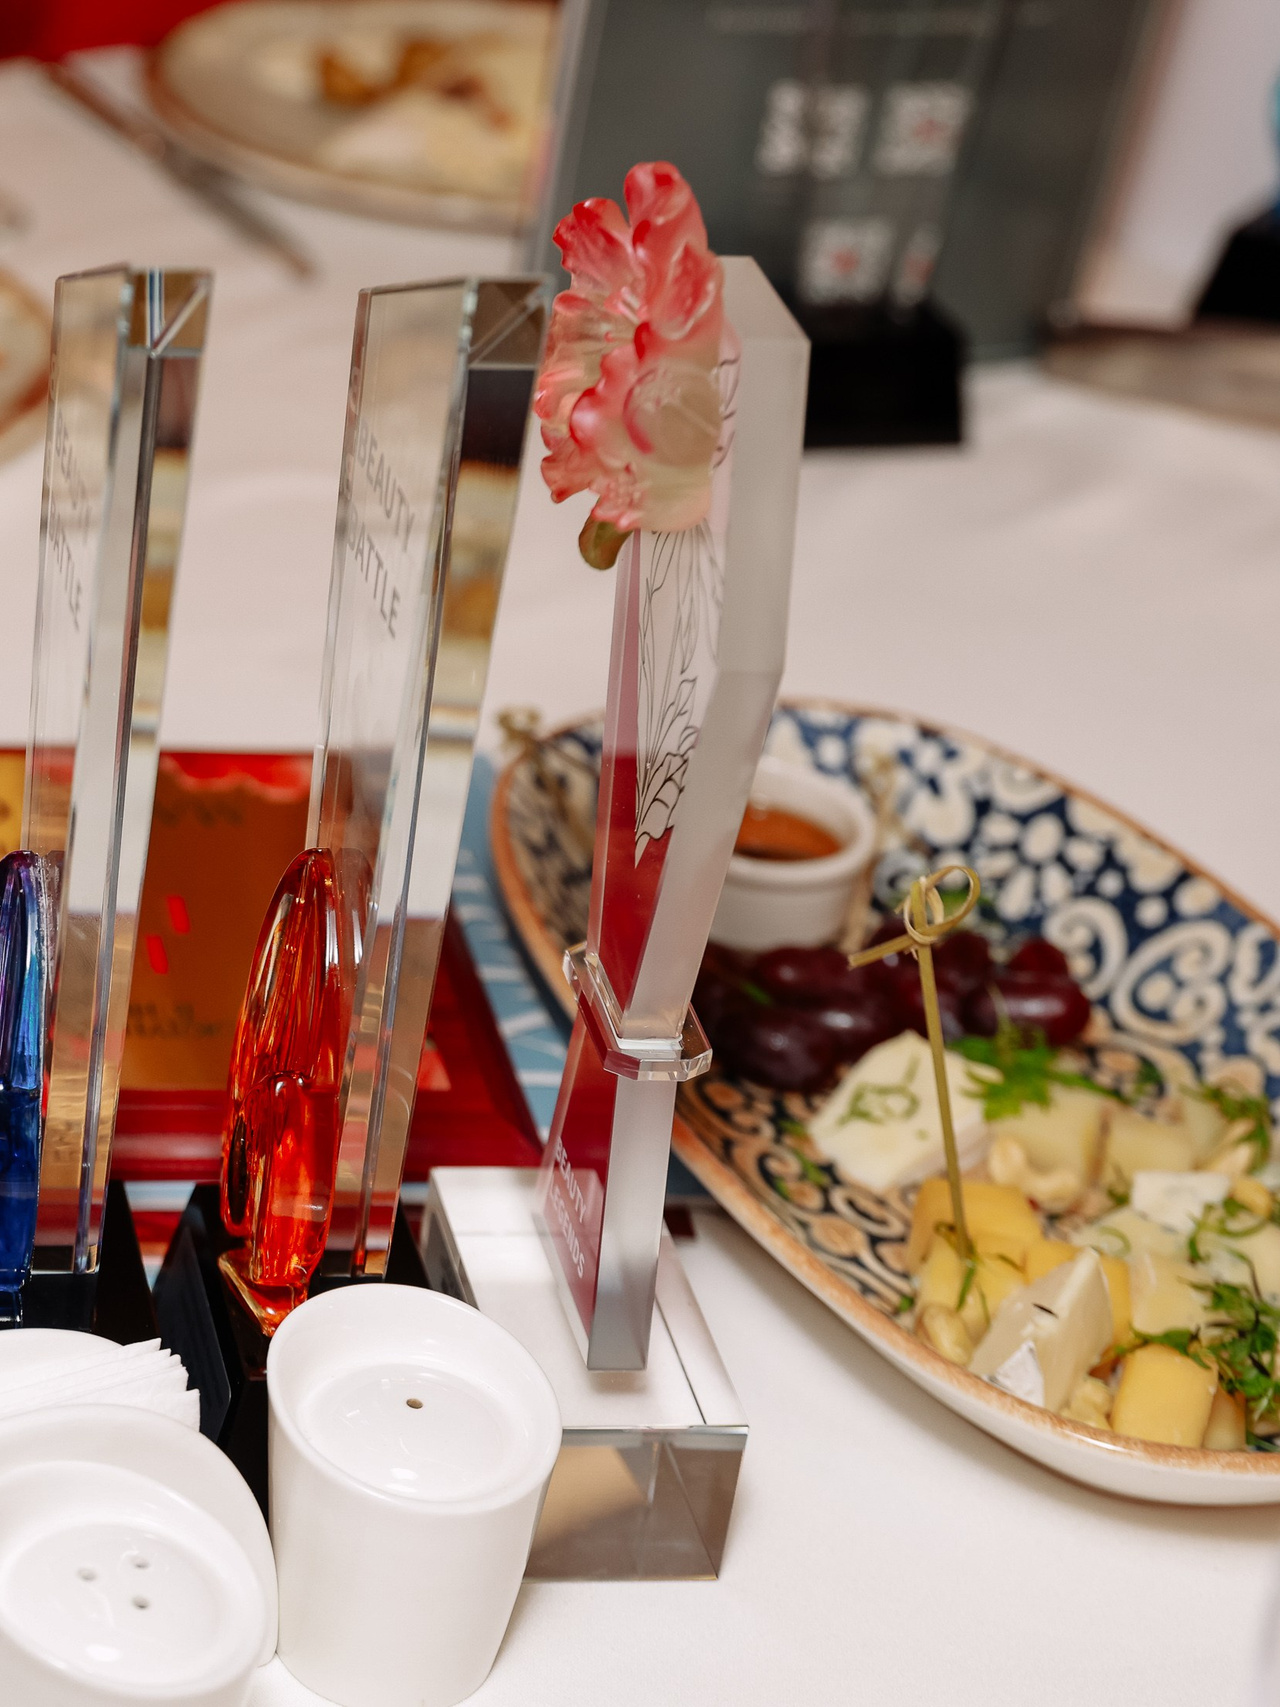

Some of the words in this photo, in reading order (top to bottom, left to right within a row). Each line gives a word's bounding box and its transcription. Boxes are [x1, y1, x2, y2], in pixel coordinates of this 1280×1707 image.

[357, 417, 415, 553] BEAUTY
[47, 494, 82, 633] BATTLE
[347, 503, 401, 639] BATTLE
[551, 1184, 586, 1279] LEGENDS
[556, 1135, 587, 1223] BEAUTY
